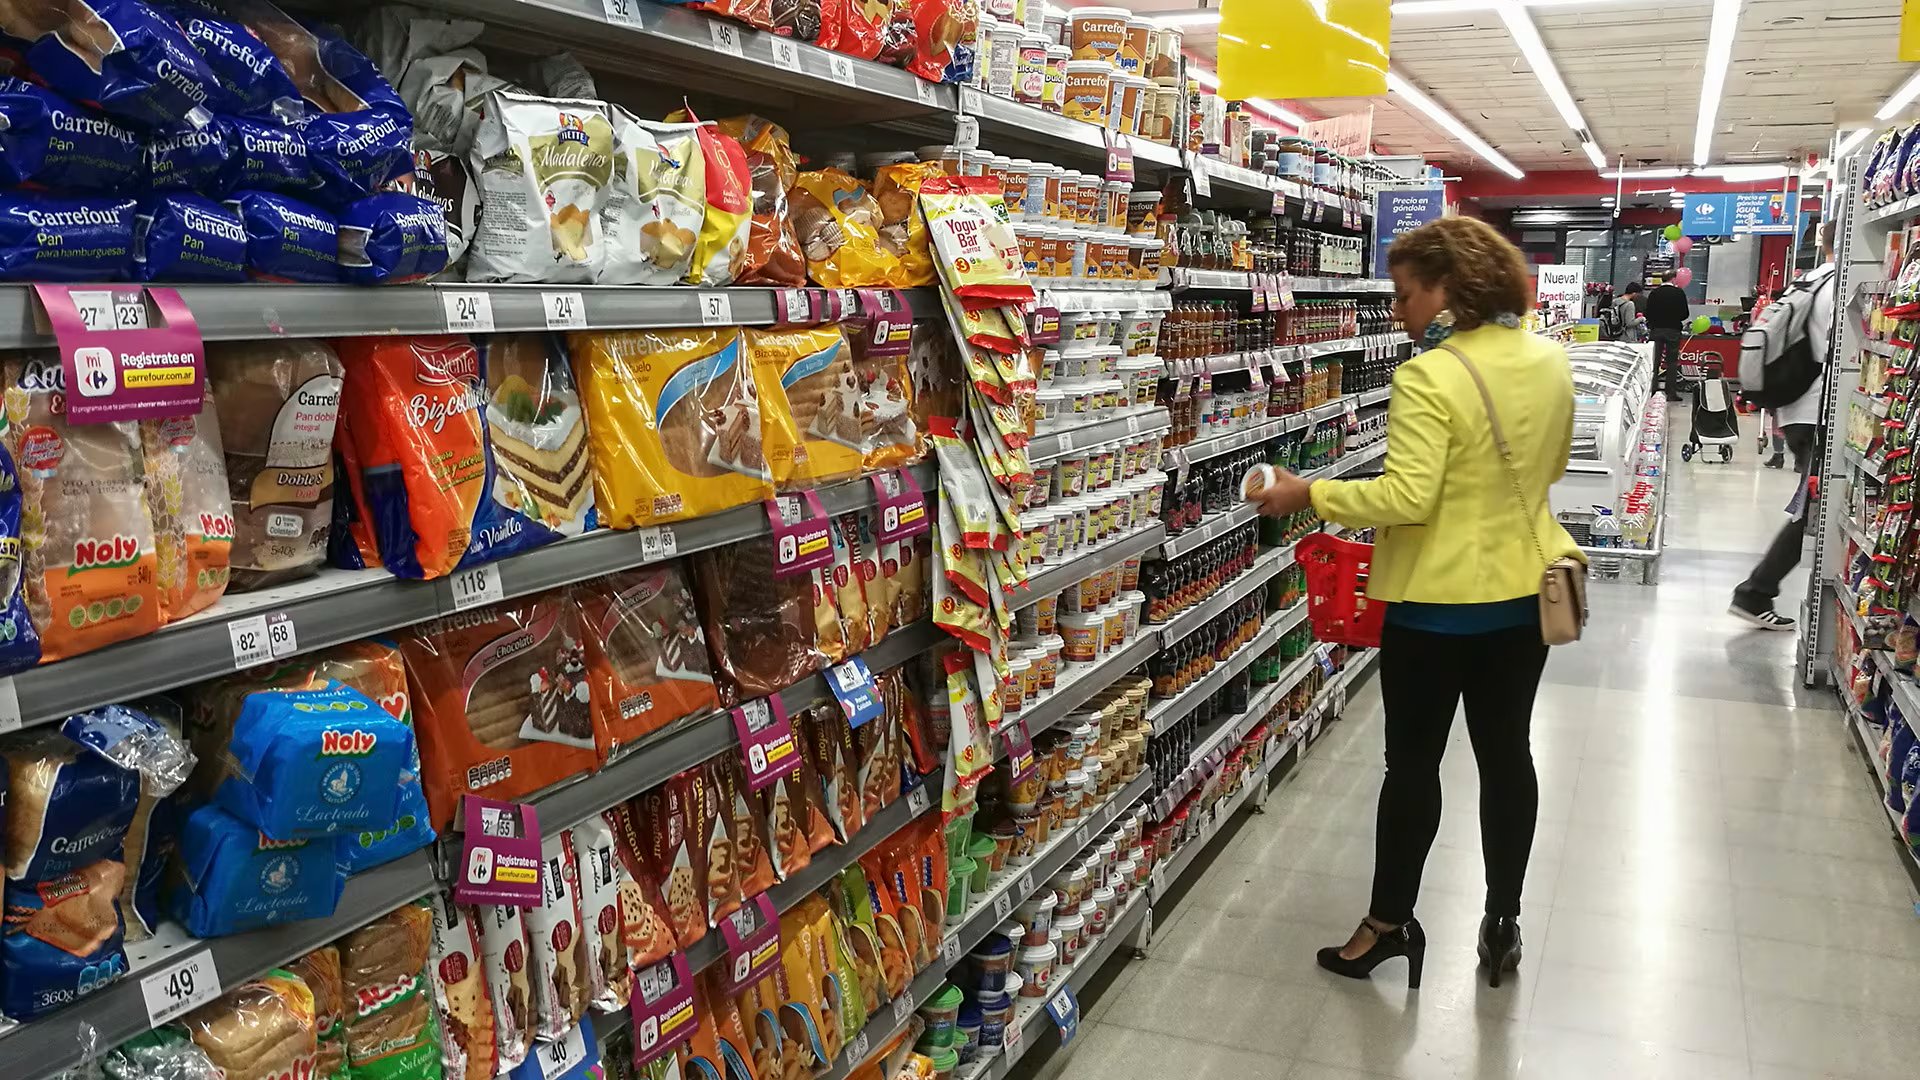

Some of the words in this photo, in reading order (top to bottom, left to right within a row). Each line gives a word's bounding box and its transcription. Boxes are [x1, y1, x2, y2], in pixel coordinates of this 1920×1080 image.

[52, 109, 135, 145] Carrefour
[49, 137, 75, 151] Pan
[336, 117, 397, 157] Carrefour
[1392, 197, 1417, 205] Precio
[1392, 204, 1426, 213] góndola
[28, 205, 120, 228] Carrefour
[278, 205, 336, 237] Carrefour
[1396, 219, 1422, 227] Precio
[283, 226, 300, 242] Pan
[945, 218, 977, 236] Yogu
[37, 233, 63, 247] Pan
[183, 234, 205, 250] Pan
[957, 233, 978, 249] Bar
[1544, 272, 1579, 284] Nueva!
[1539, 291, 1581, 304] Practicaja
[121, 352, 180, 369] Registrate
[181, 352, 195, 364] en
[127, 371, 192, 383] carrefour.com.ar
[295, 412, 314, 422] Pan
[277, 471, 314, 486] Doble
[480, 517, 522, 549] Vainilla
[75, 535, 138, 567] Noly
[271, 545, 295, 557] 540g
[496, 633, 535, 659] Chocolate
[322, 731, 377, 754] Noly
[297, 802, 370, 822] Lacteado
[694, 776, 706, 849] Carrefour
[650, 794, 663, 860] Carrefour
[620, 807, 645, 864] rrefour
[44, 859, 72, 873] Pan
[497, 854, 526, 869] Registrate
[528, 858, 538, 868] en
[41, 989, 75, 1007] 360g
